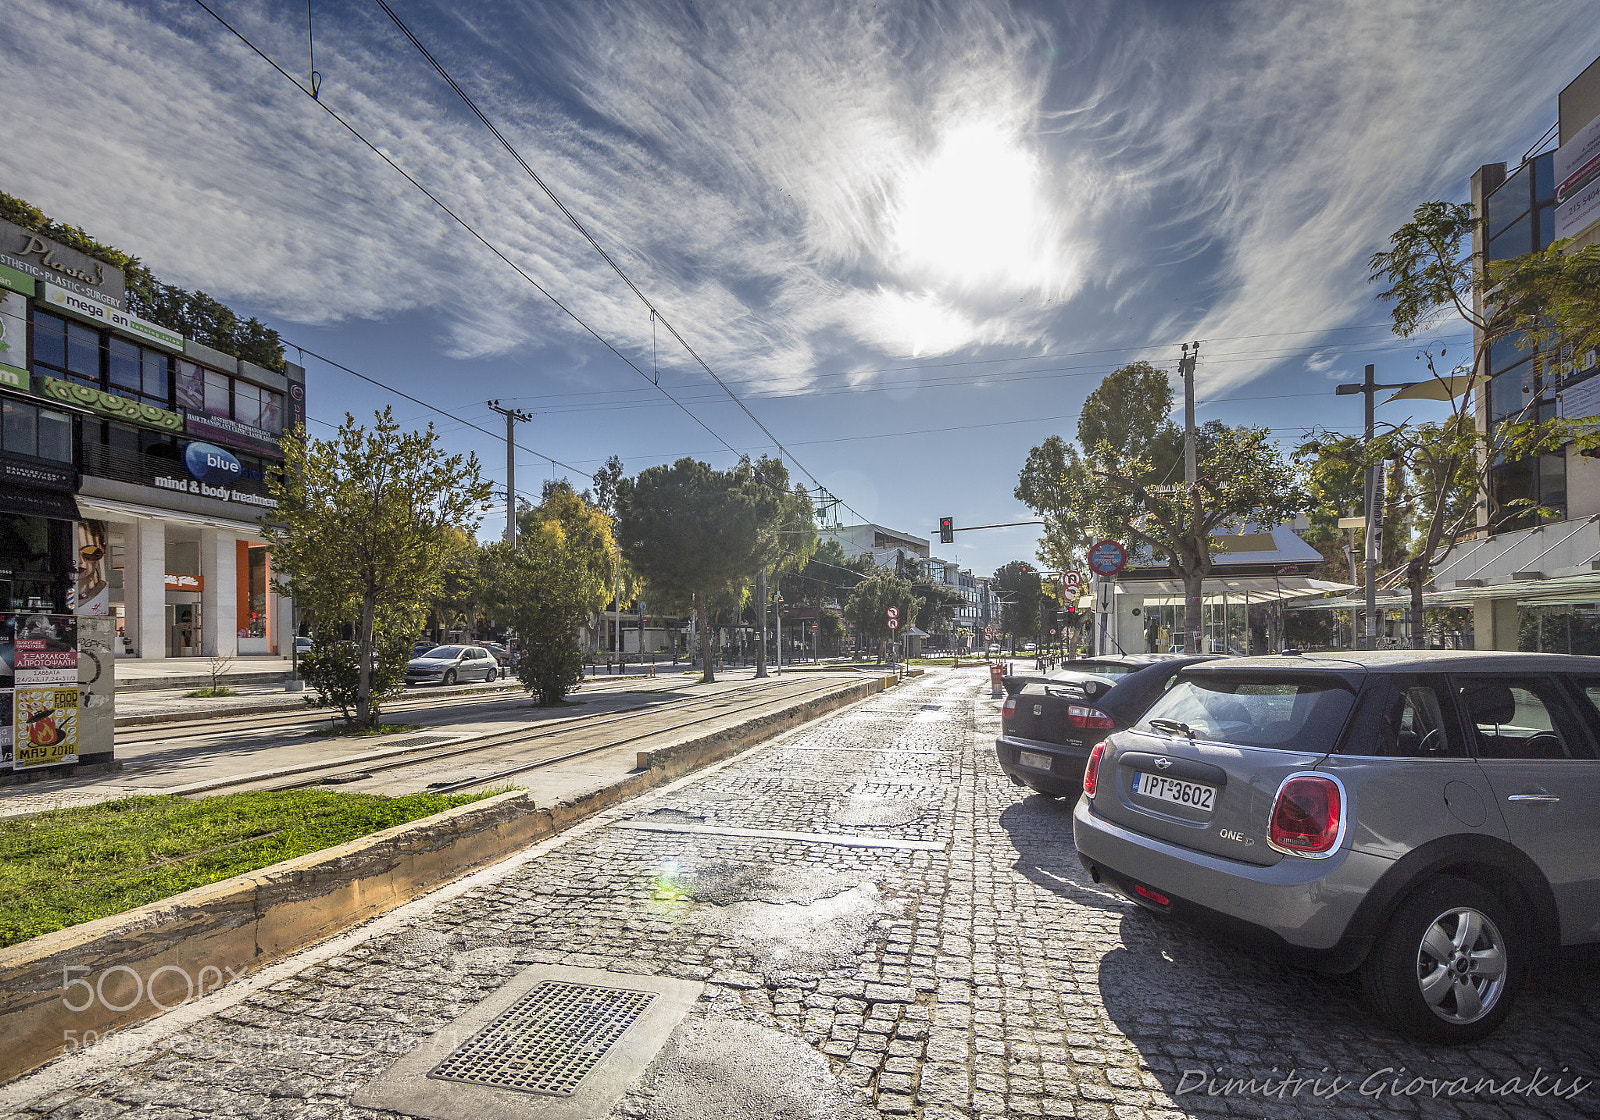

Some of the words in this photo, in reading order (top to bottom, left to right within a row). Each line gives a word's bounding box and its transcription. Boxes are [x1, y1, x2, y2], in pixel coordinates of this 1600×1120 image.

[44, 271, 81, 293] PLASTIC
[86, 287, 121, 308] SURGERY
[207, 453, 239, 473] blue
[155, 476, 187, 492] mind
[189, 481, 199, 494] &
[201, 483, 231, 501] body
[55, 693, 78, 703] FOOD
[20, 747, 47, 759] MAY
[52, 744, 75, 756] 2018
[1220, 828, 1244, 842] ONE
